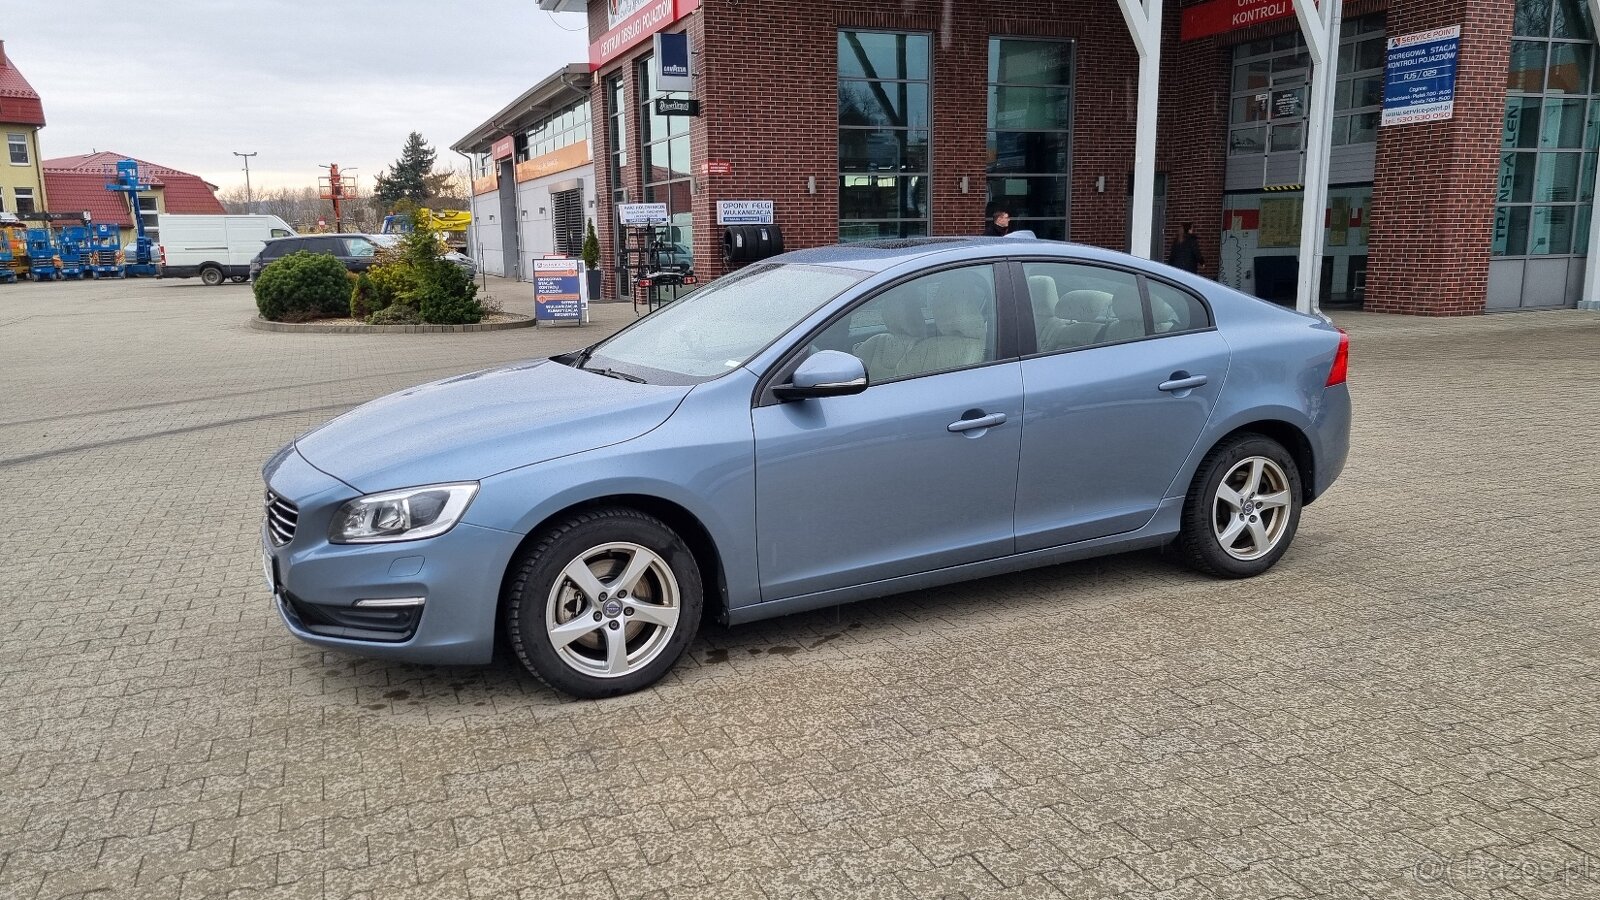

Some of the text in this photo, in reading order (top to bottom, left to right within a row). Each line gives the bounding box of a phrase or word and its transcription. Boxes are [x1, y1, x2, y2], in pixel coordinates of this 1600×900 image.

[1232, 1, 1286, 25] KONTROLI
[600, 31, 621, 57] CENTRUM
[1401, 32, 1432, 44] SERVICE
[1432, 28, 1456, 38] POINT
[1387, 51, 1456, 70] KONTROLI POJAZDÓW
[1388, 43, 1457, 61] OKRĘGOWA STACJA
[663, 64, 687, 73] LAVAZZA
[1403, 72, 1417, 80] RJS
[1422, 69, 1437, 77] 029
